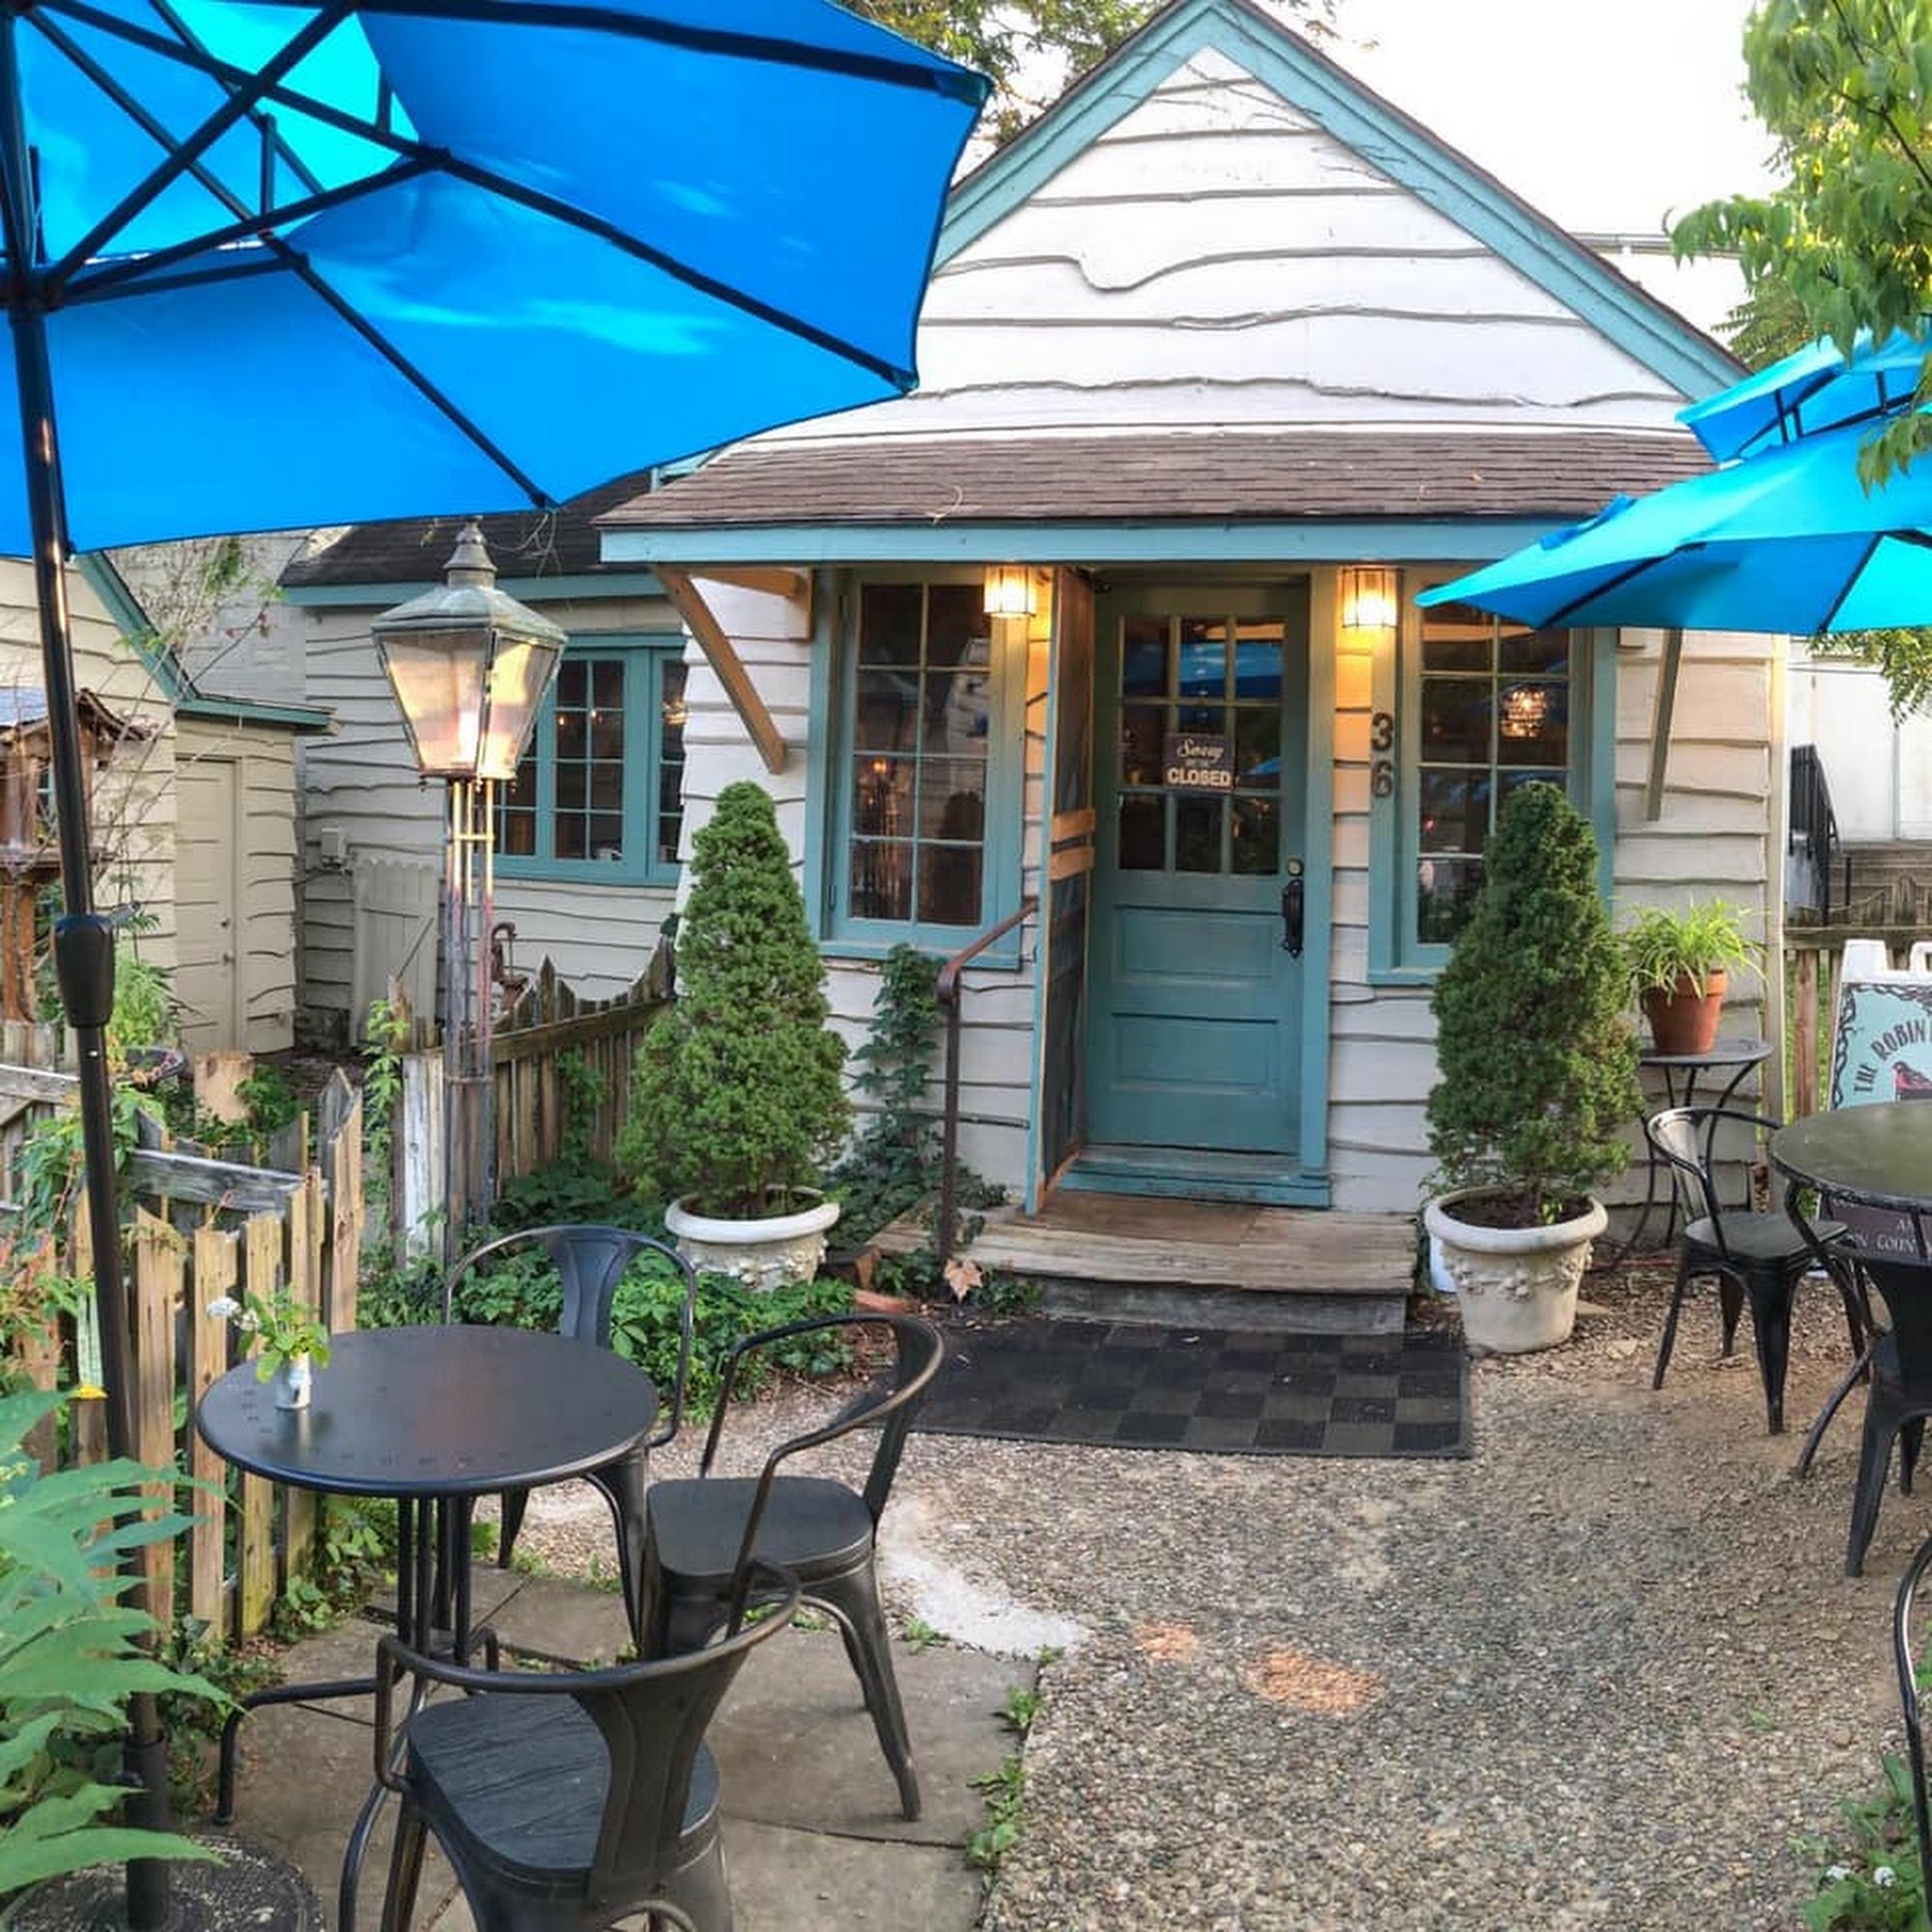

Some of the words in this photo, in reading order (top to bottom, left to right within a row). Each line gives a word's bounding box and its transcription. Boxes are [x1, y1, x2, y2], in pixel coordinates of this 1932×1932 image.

[1167, 767, 1232, 787] CLOSED
[1371, 712, 1393, 799] 36
[1853, 1064, 1878, 1093] THE
[1870, 1018, 1926, 1062] ROBIN
